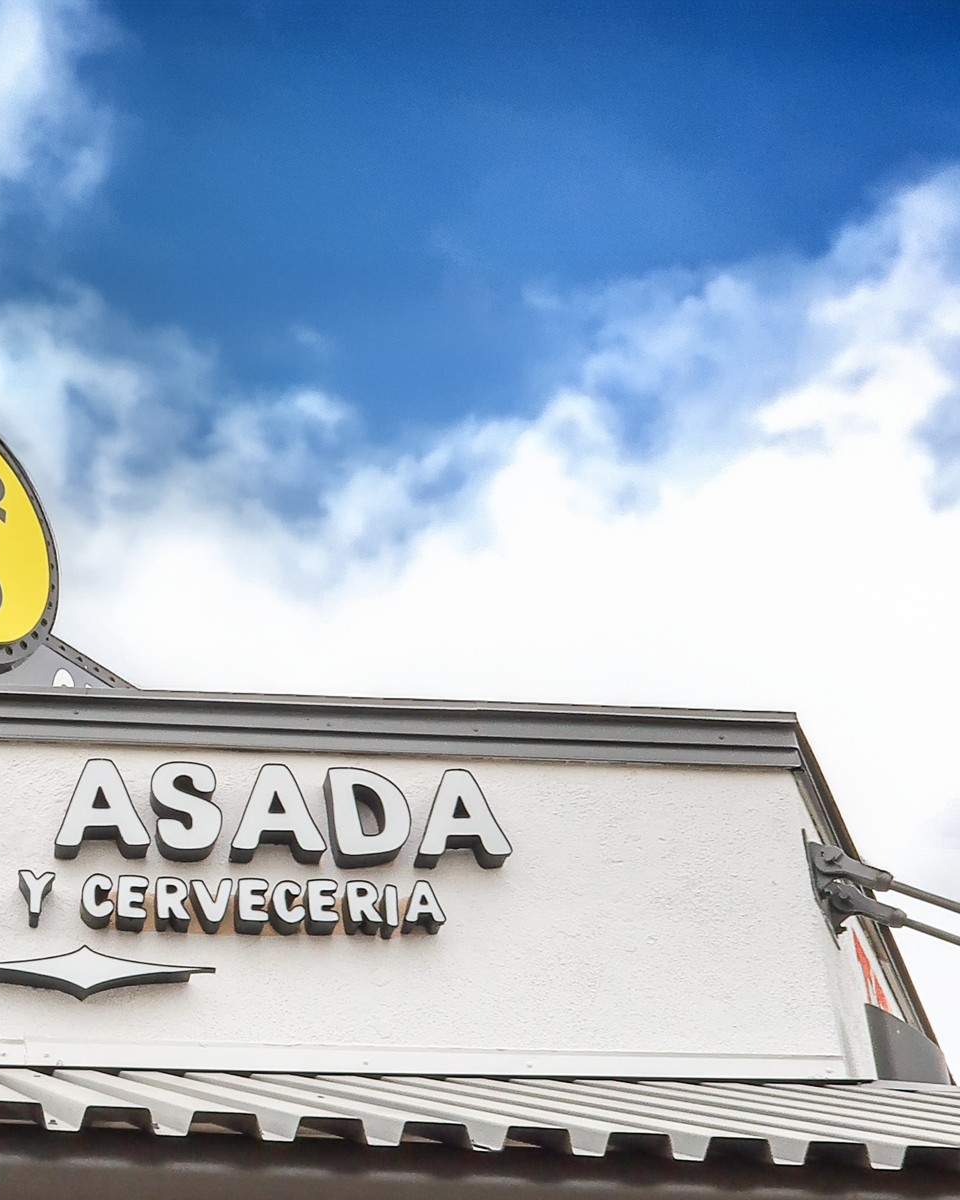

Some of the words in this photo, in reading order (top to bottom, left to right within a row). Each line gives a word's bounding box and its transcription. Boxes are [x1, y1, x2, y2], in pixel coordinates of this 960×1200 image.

[55, 759, 513, 868] ASADA
[18, 870, 57, 927] Y
[81, 874, 447, 938] CERVECERIA
